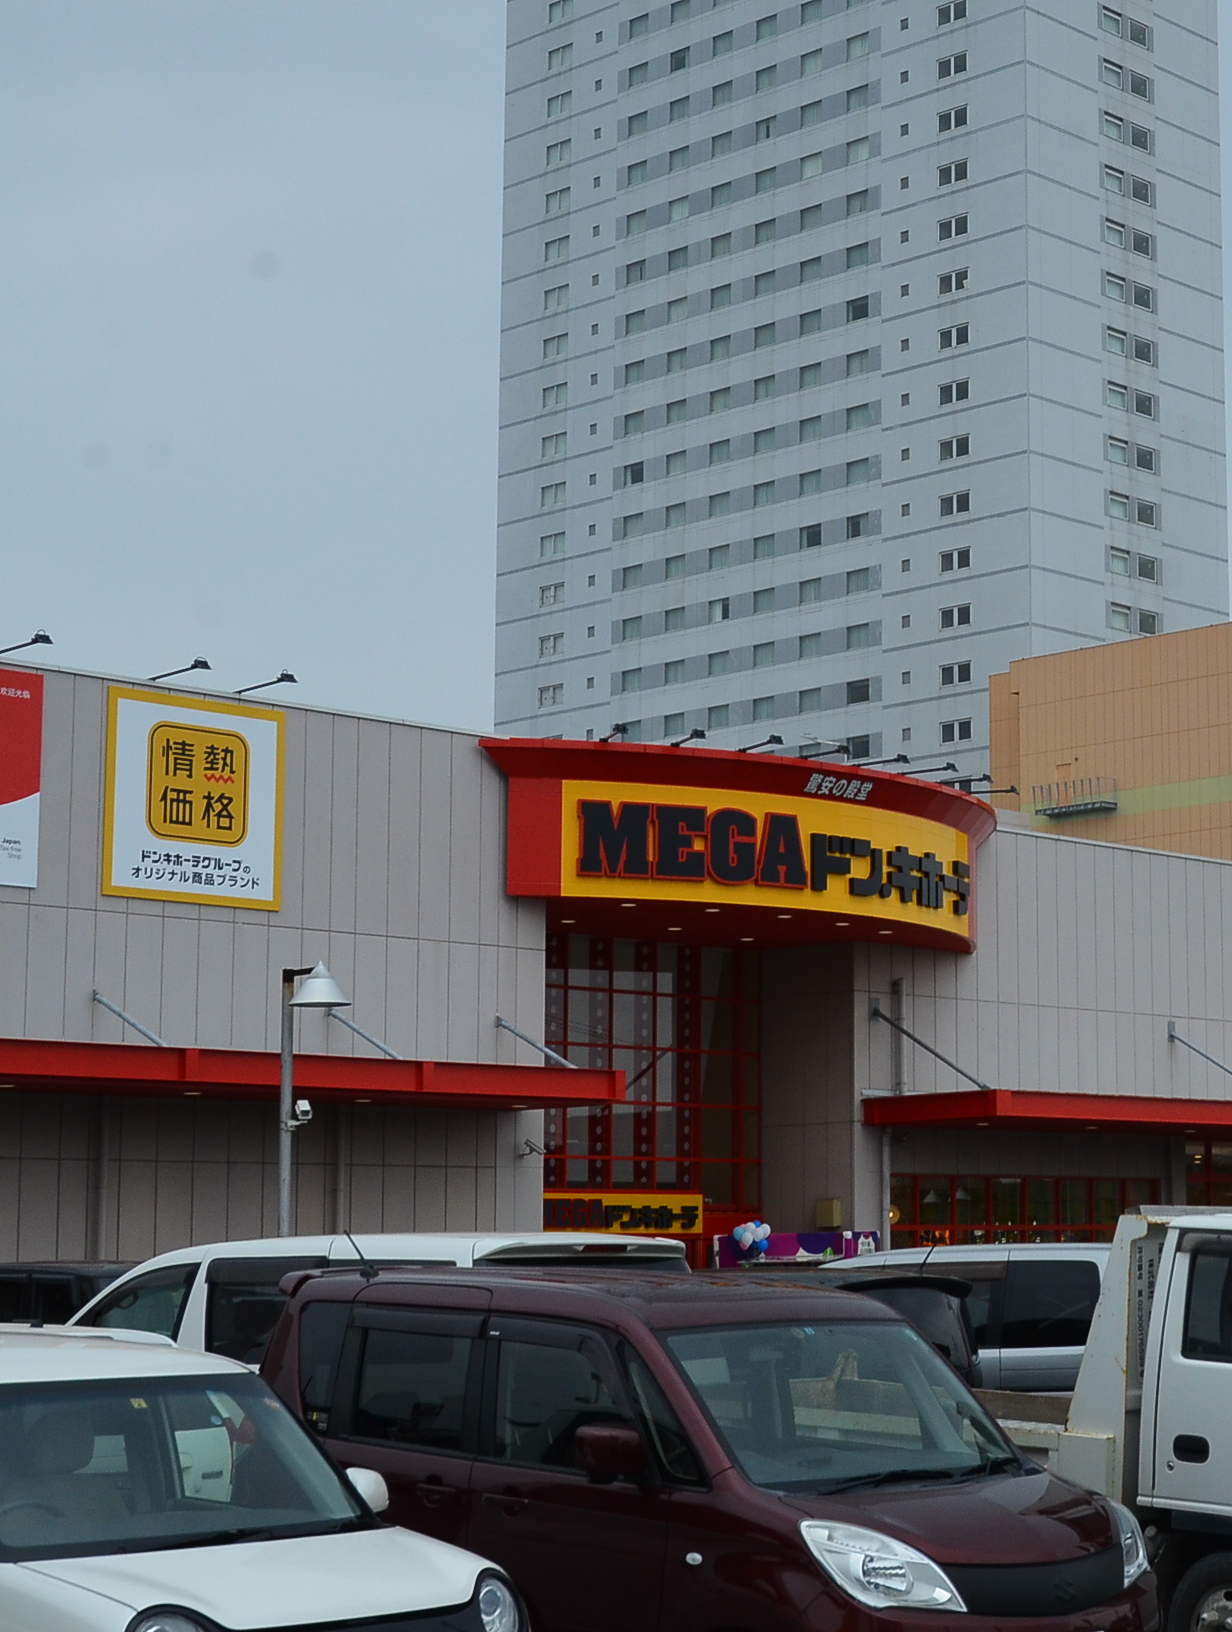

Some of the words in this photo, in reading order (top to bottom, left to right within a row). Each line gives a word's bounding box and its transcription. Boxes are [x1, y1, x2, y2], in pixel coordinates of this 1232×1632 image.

[162, 738, 237, 784] 情熱
[159, 785, 235, 831] 価格
[804, 773, 873, 800] 驚安の殿堂
[577, 798, 808, 889] MEGA
[131, 866, 260, 890] オリジナル商品ブランド
